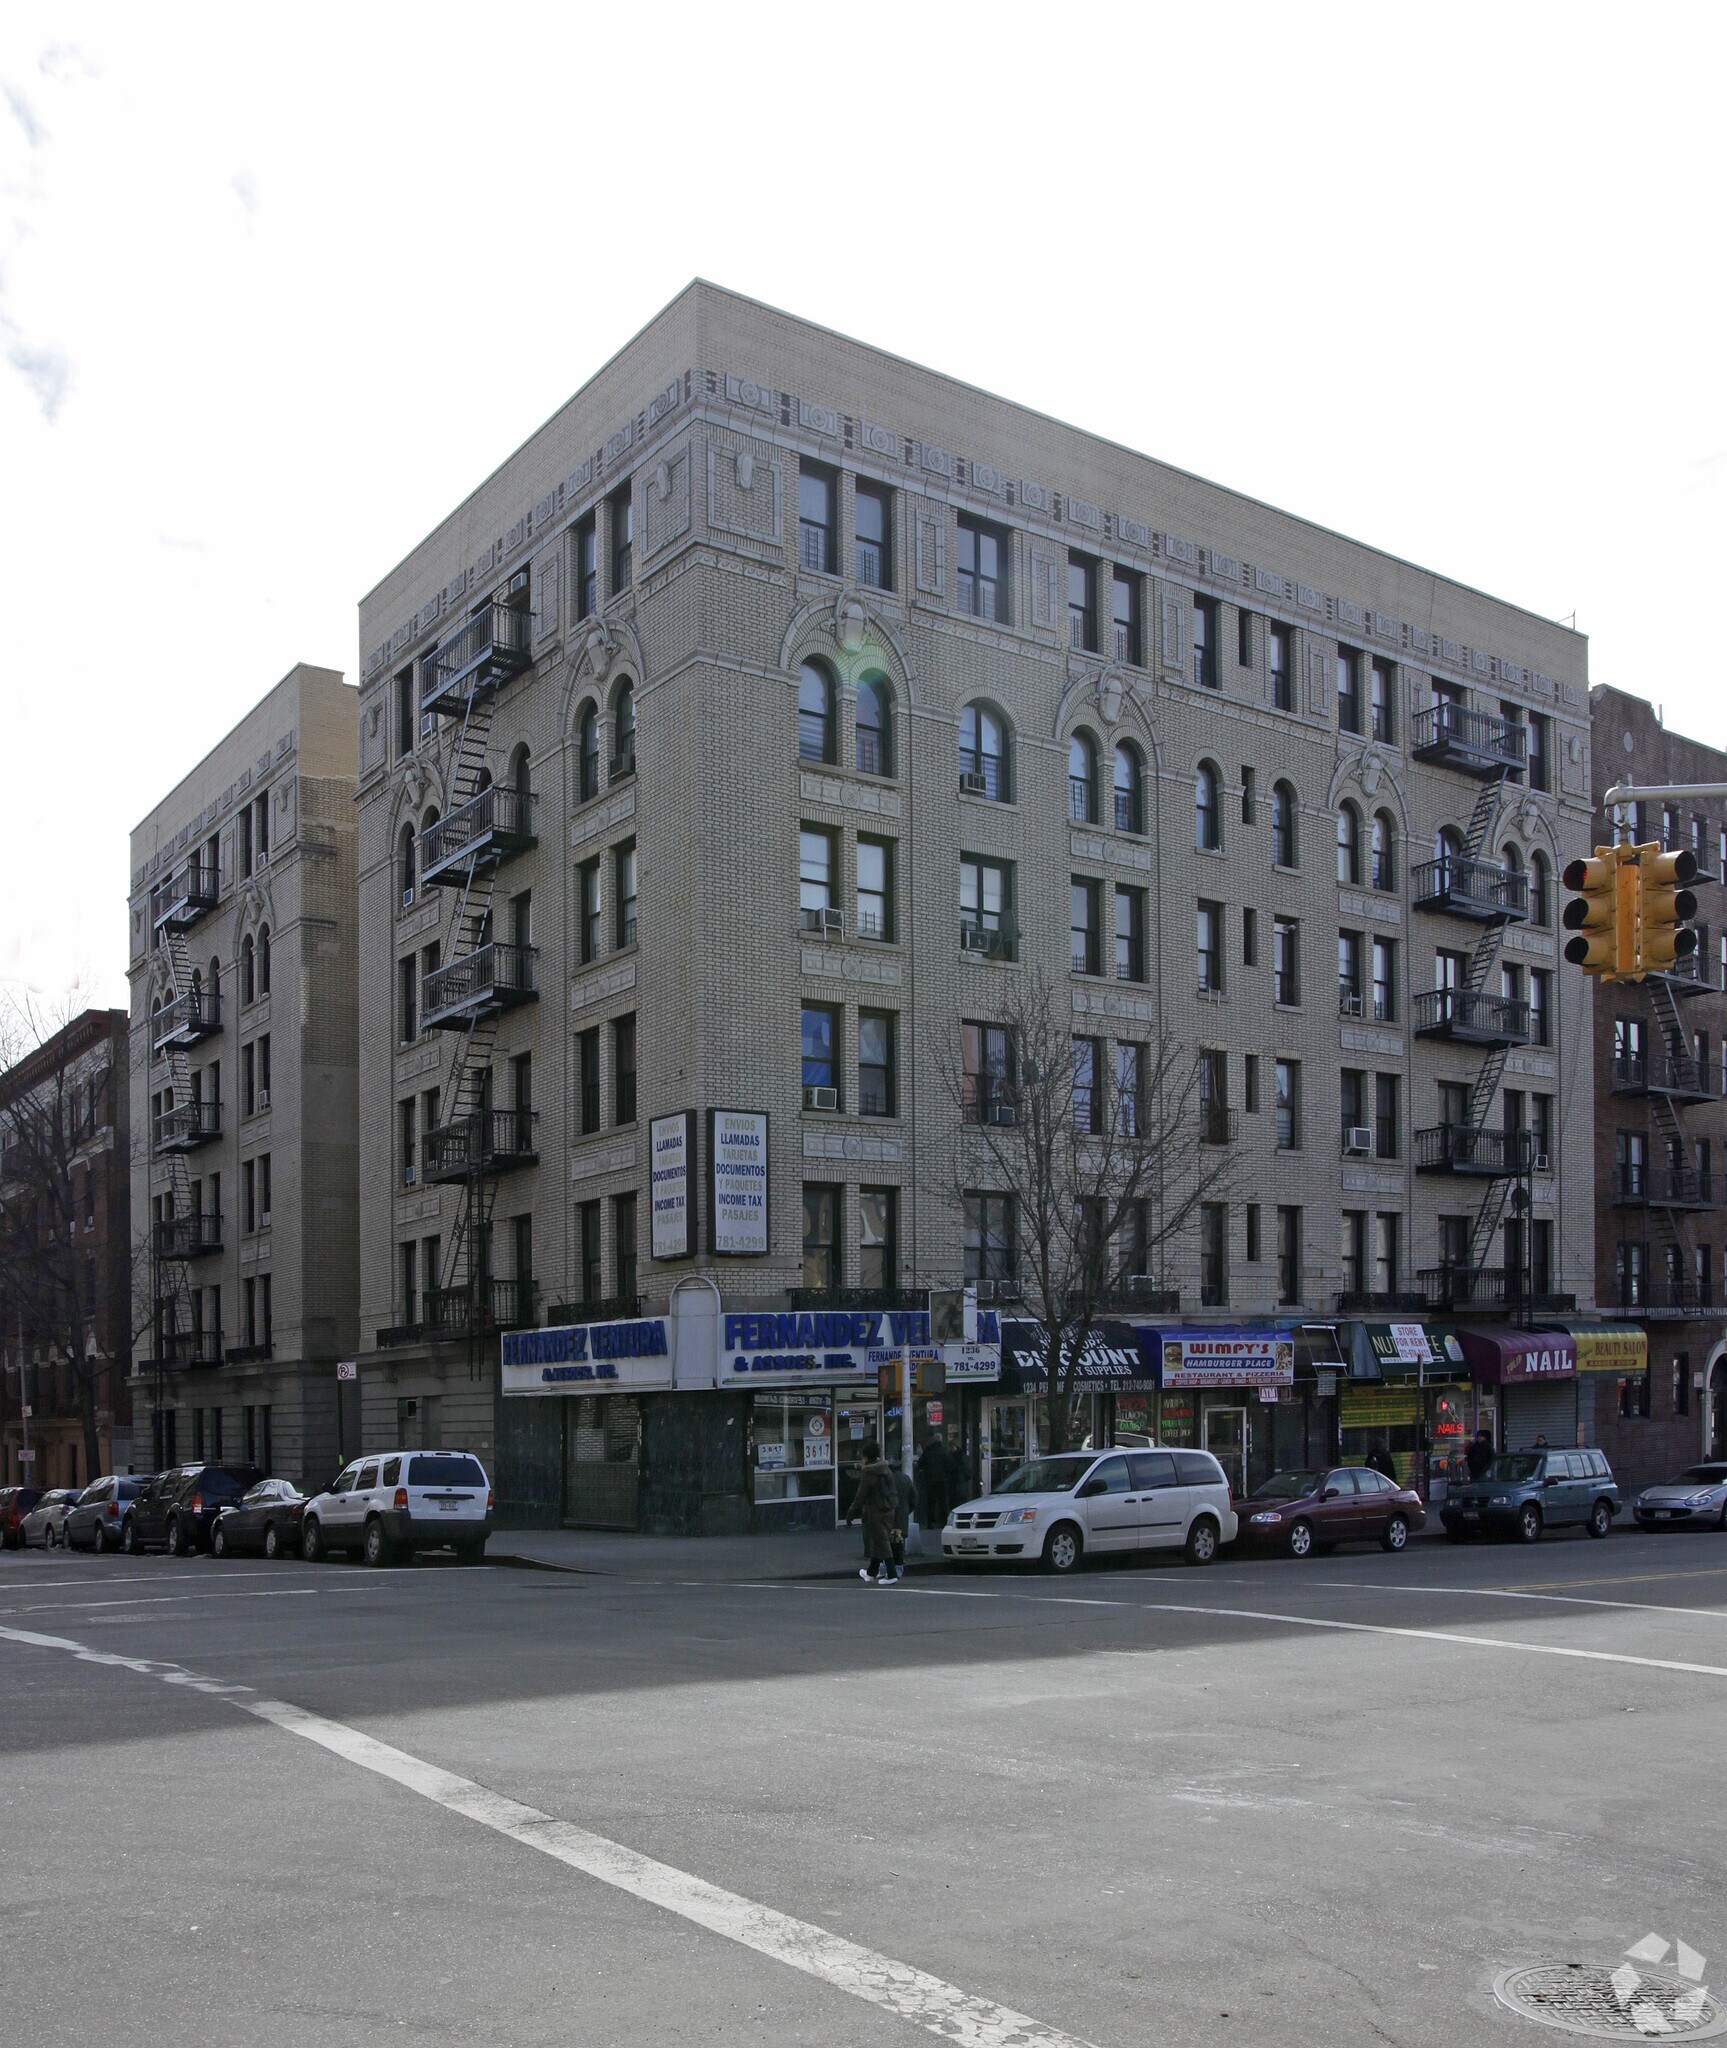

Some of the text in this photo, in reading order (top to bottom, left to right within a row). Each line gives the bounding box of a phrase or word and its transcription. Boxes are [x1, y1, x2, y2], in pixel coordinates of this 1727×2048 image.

[725, 1118, 755, 1131] ENVIOS
[656, 1136, 682, 1152] LLAMADAS
[721, 1133, 760, 1146] LLAMADAS
[722, 1148, 758, 1161] TARJETAS
[653, 1165, 686, 1182] DOCUMENTOS
[716, 1163, 765, 1176] DOCUMENTOS
[725, 1179, 762, 1191] PAQUETES
[655, 1195, 685, 1211] INCOME TAX
[719, 1194, 762, 1207] INCOME TAX
[722, 1209, 759, 1221] PASAJES
[717, 1235, 764, 1248] 781-4299
[725, 1312, 885, 1350] FERNANDEZ
[1397, 1327, 1418, 1336] STORE
[503, 1320, 668, 1365] FERNANDEZ VENTURA
[1190, 1343, 1269, 1354] WIMPY'S
[1396, 1337, 1427, 1347] FOR RENT
[1595, 1341, 1620, 1355] BEAUTY
[1623, 1341, 1646, 1355] SALON
[869, 1350, 901, 1362] FERNANDE
[961, 1346, 980, 1354] 1236
[734, 1356, 749, 1371] &
[824, 1353, 856, 1369] INC.
[954, 1361, 996, 1371] 781-4299
[1186, 1359, 1272, 1368] HAMBURGER PLACE
[1525, 1349, 1572, 1373] NAIL
[1085, 1365, 1132, 1376] SUPPLIES
[1073, 1380, 1104, 1392] COSMETICS
[1261, 1388, 1276, 1398] ATM
[1438, 1423, 1463, 1433] NAILS
